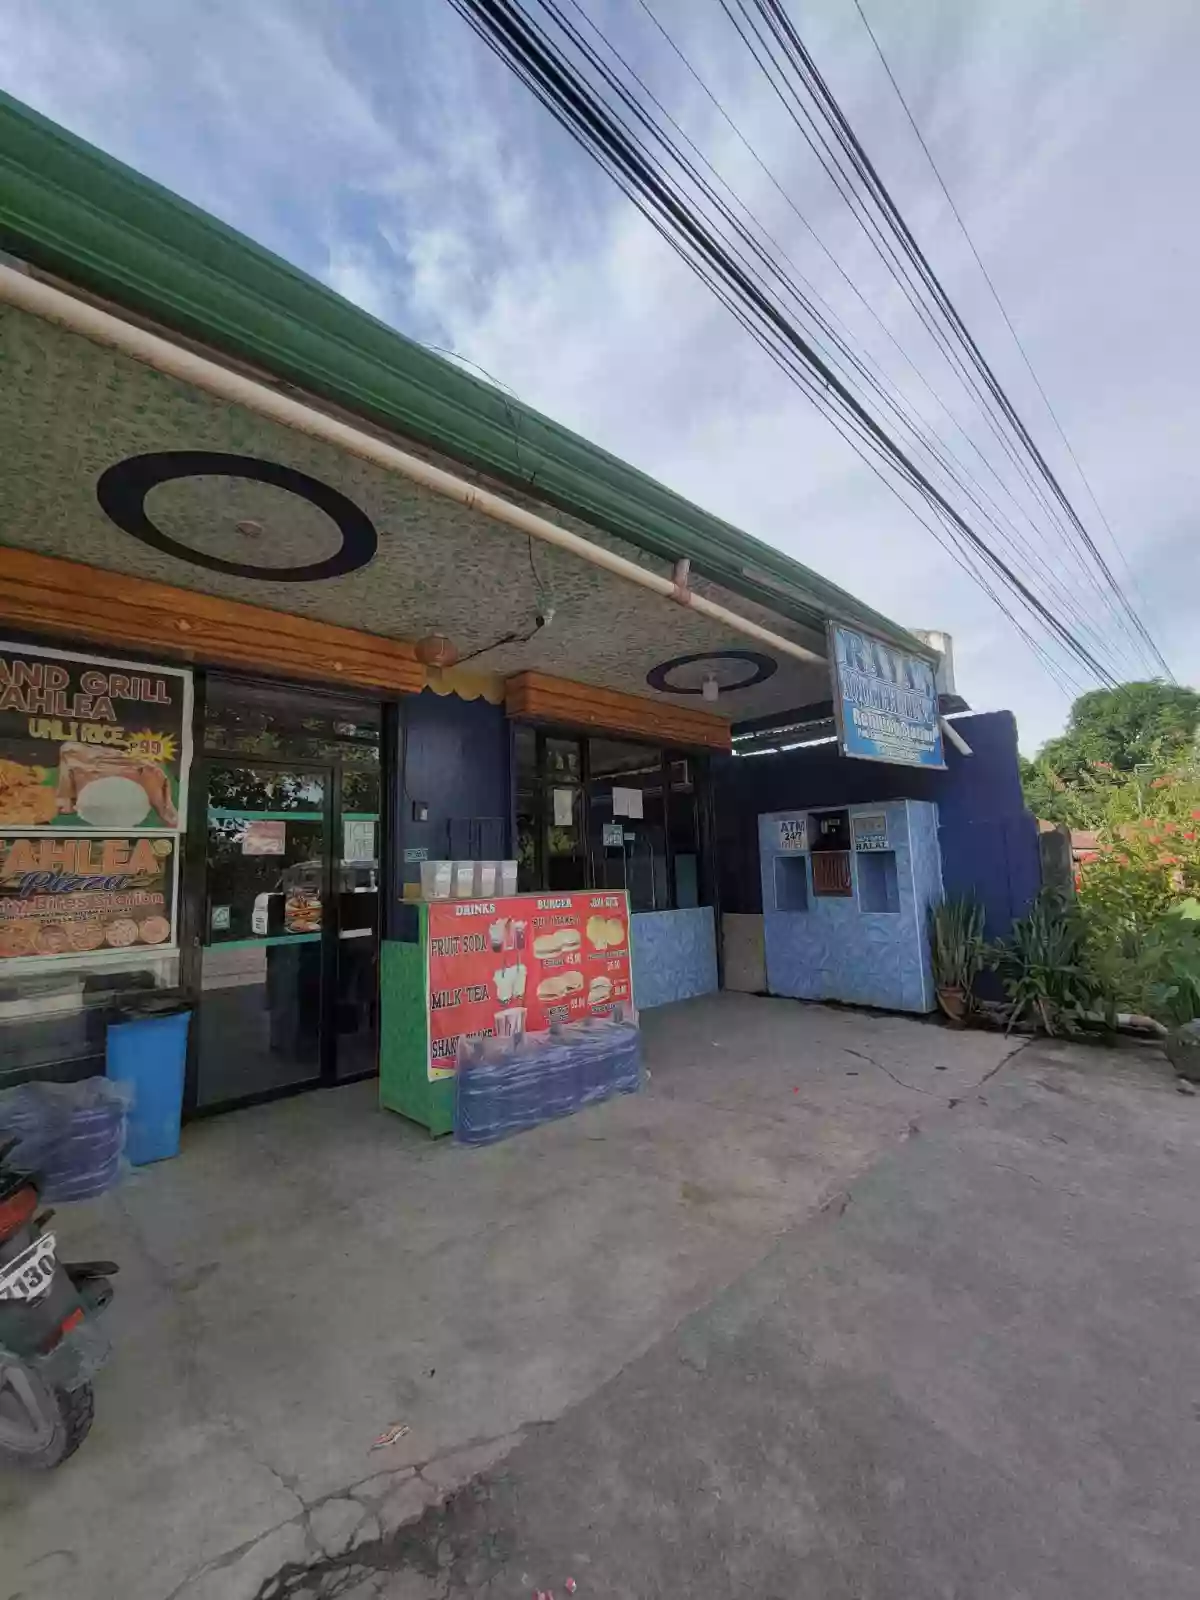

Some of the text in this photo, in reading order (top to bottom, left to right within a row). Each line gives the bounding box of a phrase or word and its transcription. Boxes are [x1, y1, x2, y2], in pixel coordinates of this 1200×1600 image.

[80, 671, 170, 704] GRILL
[780, 821, 805, 833] ATM
[0, 839, 160, 875] AHLEA
[20, 871, 128, 899] Pizza
[455, 903, 496, 916] DRINKS
[431, 934, 487, 957] FRUIT SODA
[431, 984, 490, 1011] MILK TEA
